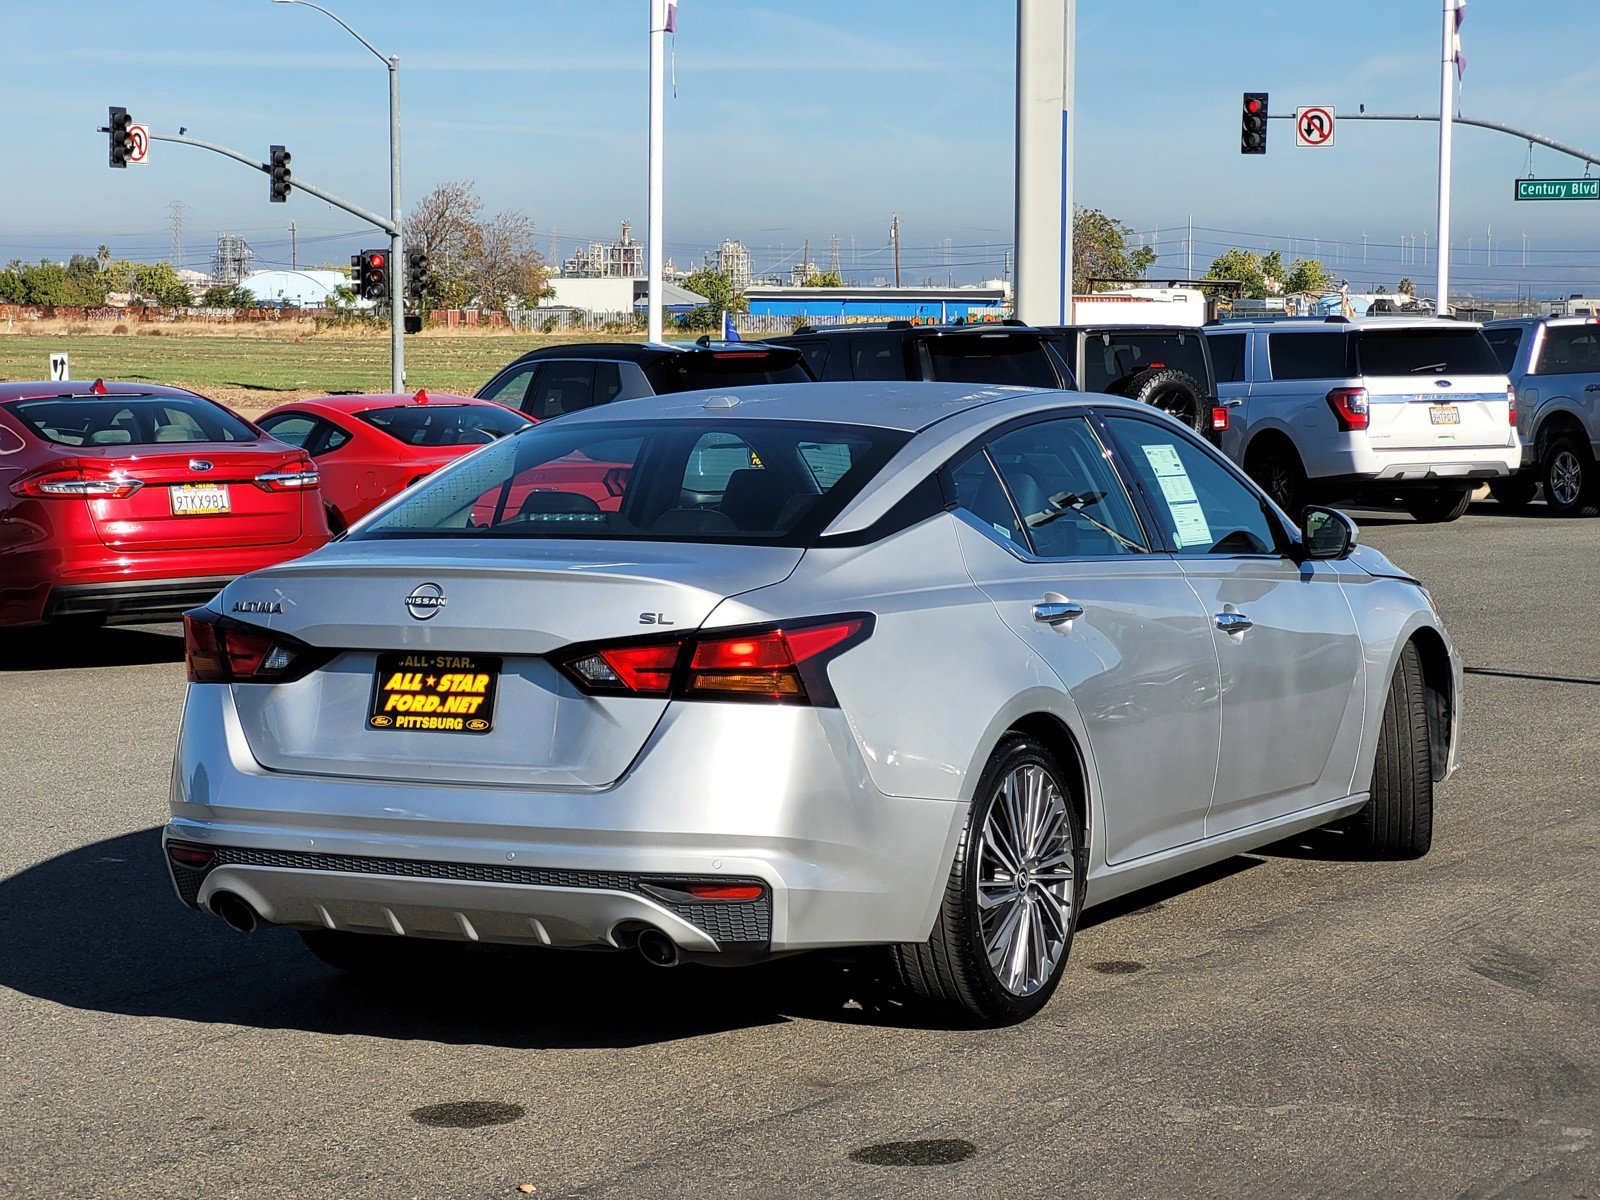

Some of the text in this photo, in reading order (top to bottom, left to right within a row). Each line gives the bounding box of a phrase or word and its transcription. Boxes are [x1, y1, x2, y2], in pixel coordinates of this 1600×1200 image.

[1520, 182, 1598, 198] Century Blvd
[176, 494, 225, 511] 9TKX981
[232, 601, 284, 615] ALTIMA
[406, 597, 446, 606] NISSAN
[639, 612, 675, 625] SL
[404, 656, 470, 668] ALL STAR
[383, 672, 490, 693] ALL STAR
[383, 693, 484, 714] FORD.NET
[395, 715, 464, 730] PITTSBURG
